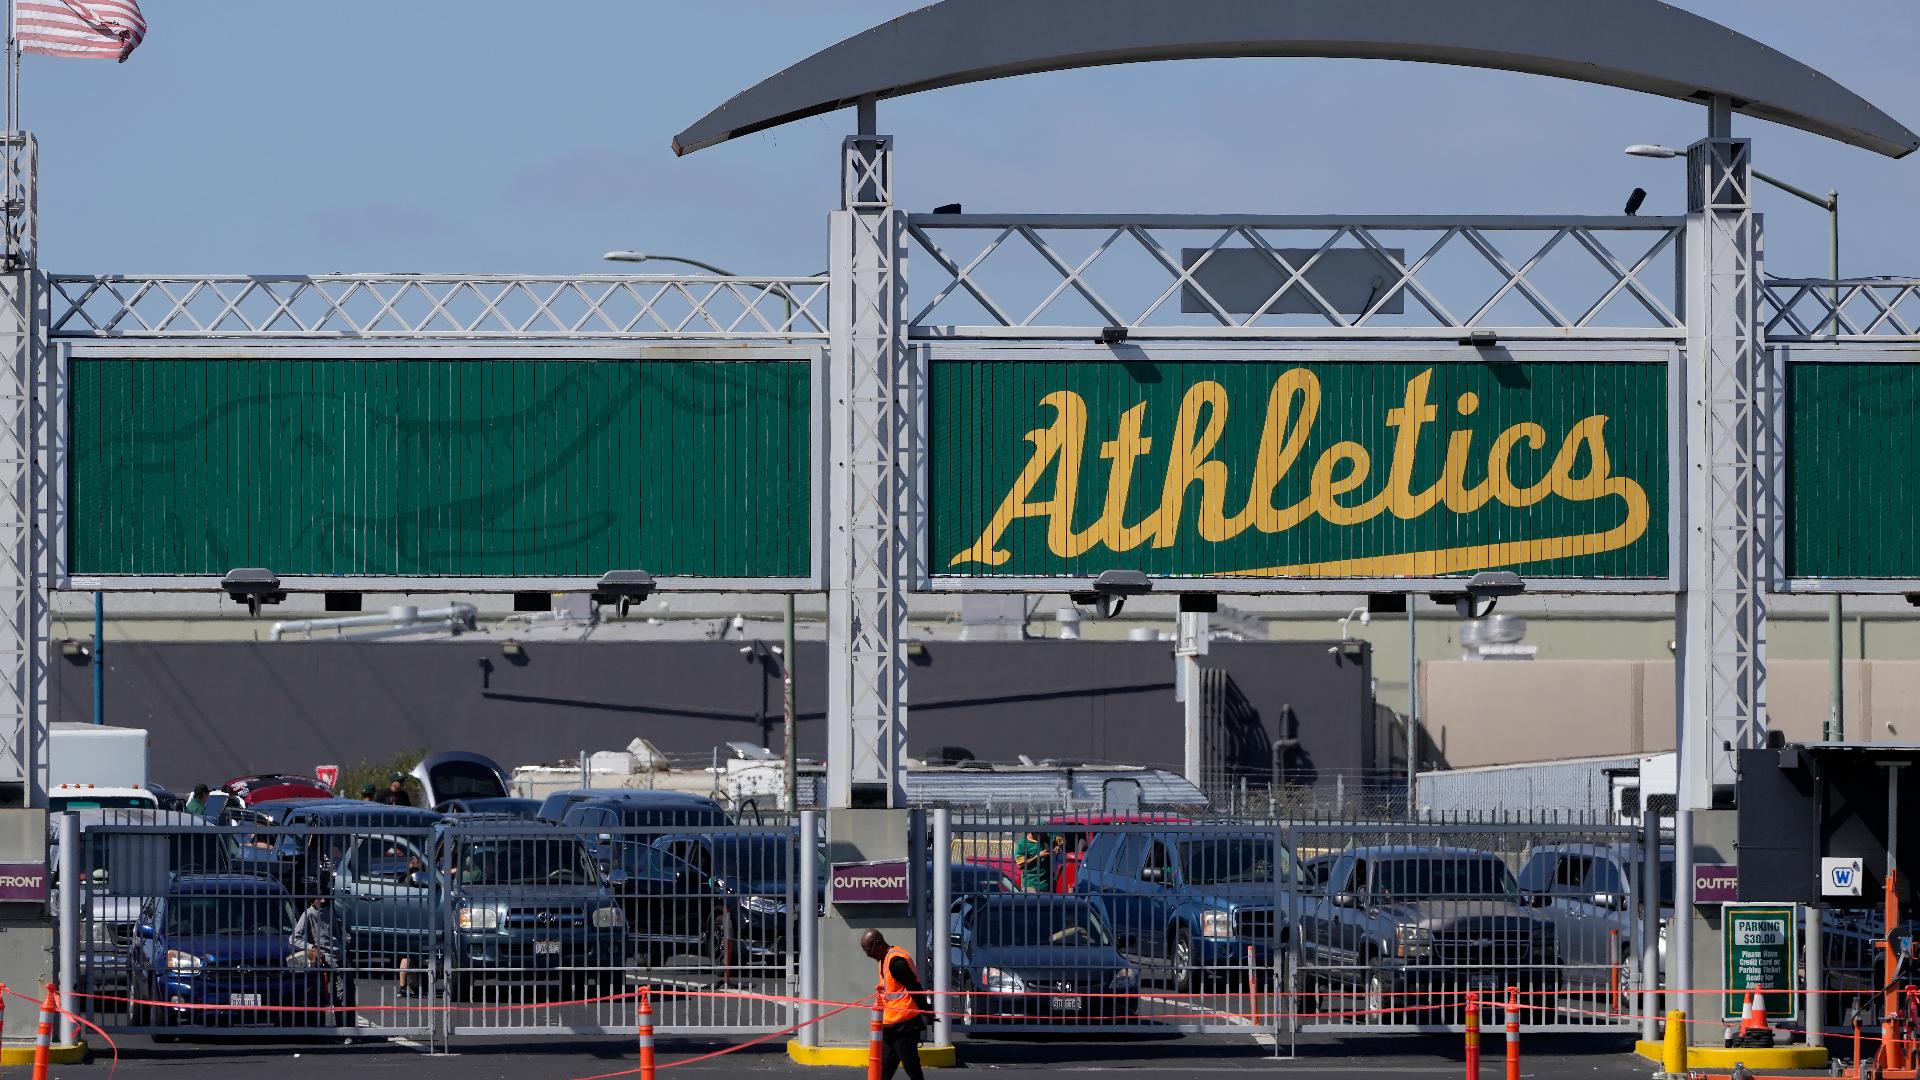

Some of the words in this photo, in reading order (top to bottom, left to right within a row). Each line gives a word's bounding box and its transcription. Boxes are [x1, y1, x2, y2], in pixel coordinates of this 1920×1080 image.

[948, 367, 1649, 577] Athletics
[834, 876, 905, 888] OUTFRONT
[1835, 870, 1850, 883] W
[1739, 922, 1779, 931] PARKING
[1744, 934, 1775, 944] $30.00
[1739, 966, 1761, 974] Parking
